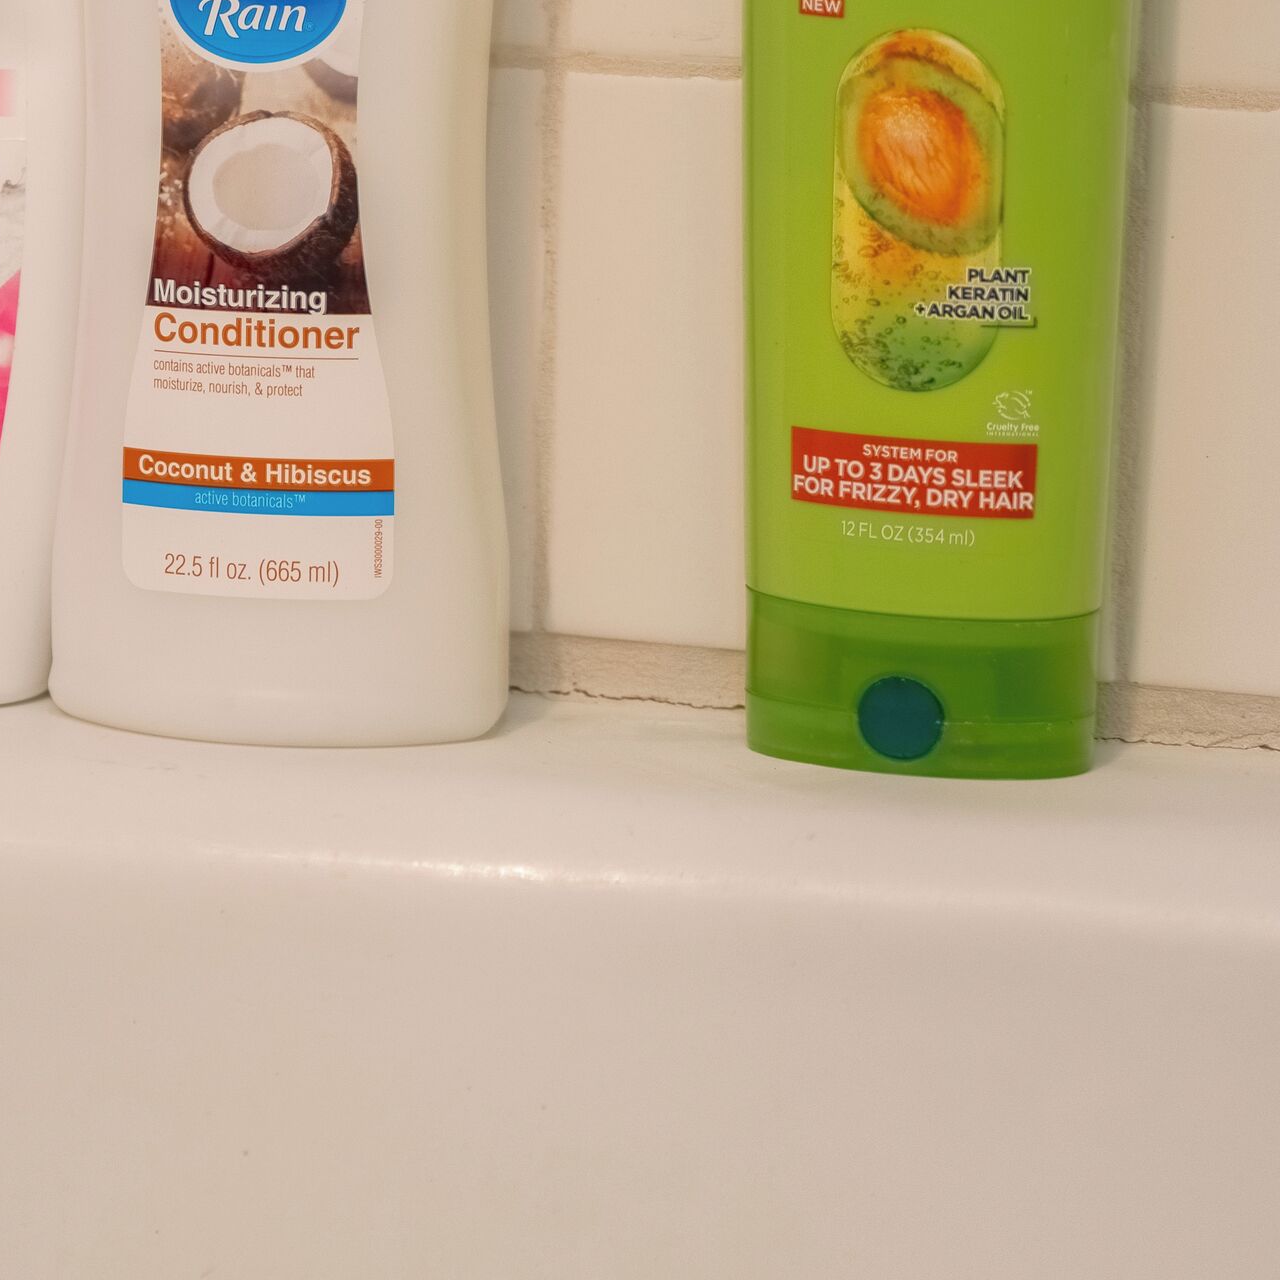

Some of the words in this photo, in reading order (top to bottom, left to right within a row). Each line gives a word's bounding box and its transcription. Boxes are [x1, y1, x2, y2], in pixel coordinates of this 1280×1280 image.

[968, 268, 1030, 283] PLANT
[153, 277, 327, 315] Moisturizing
[948, 286, 1028, 301] KERATIN
[998, 306, 1028, 320] OIL
[154, 312, 360, 350] Conditioner
[153, 359, 193, 373] contains
[197, 361, 225, 375] active
[296, 365, 315, 378] that
[153, 377, 205, 393] moisturize,
[209, 381, 250, 396] nourish,
[255, 382, 263, 395] &
[266, 384, 302, 398] protect
[986, 422, 1019, 432] Cruelty
[1021, 423, 1040, 431] Free
[863, 443, 921, 460] SYSTEM
[925, 449, 958, 463] FOR
[139, 454, 232, 481] Coconut
[240, 462, 257, 483] &
[265, 463, 371, 485] Hibiscus
[803, 455, 830, 473] UP
[835, 459, 864, 478] TO
[870, 462, 882, 480] 3
[888, 464, 945, 485] DAYS
[951, 469, 1023, 489] SLEEK
[195, 491, 229, 506] active
[793, 474, 833, 497] FOR
[839, 481, 921, 509] FRIZZY,
[926, 489, 973, 509] DRY
[979, 491, 1033, 511] HAIR
[841, 520, 856, 537] 12
[859, 522, 877, 539] FL
[881, 524, 904, 542] OZ
[908, 525, 944, 545] (354
[949, 529, 975, 547] ml)
[165, 553, 202, 577] 22.5
[209, 556, 219, 579] fl
[226, 561, 251, 581] oz.
[259, 558, 301, 585] (665
[308, 560, 339, 587] ml)
